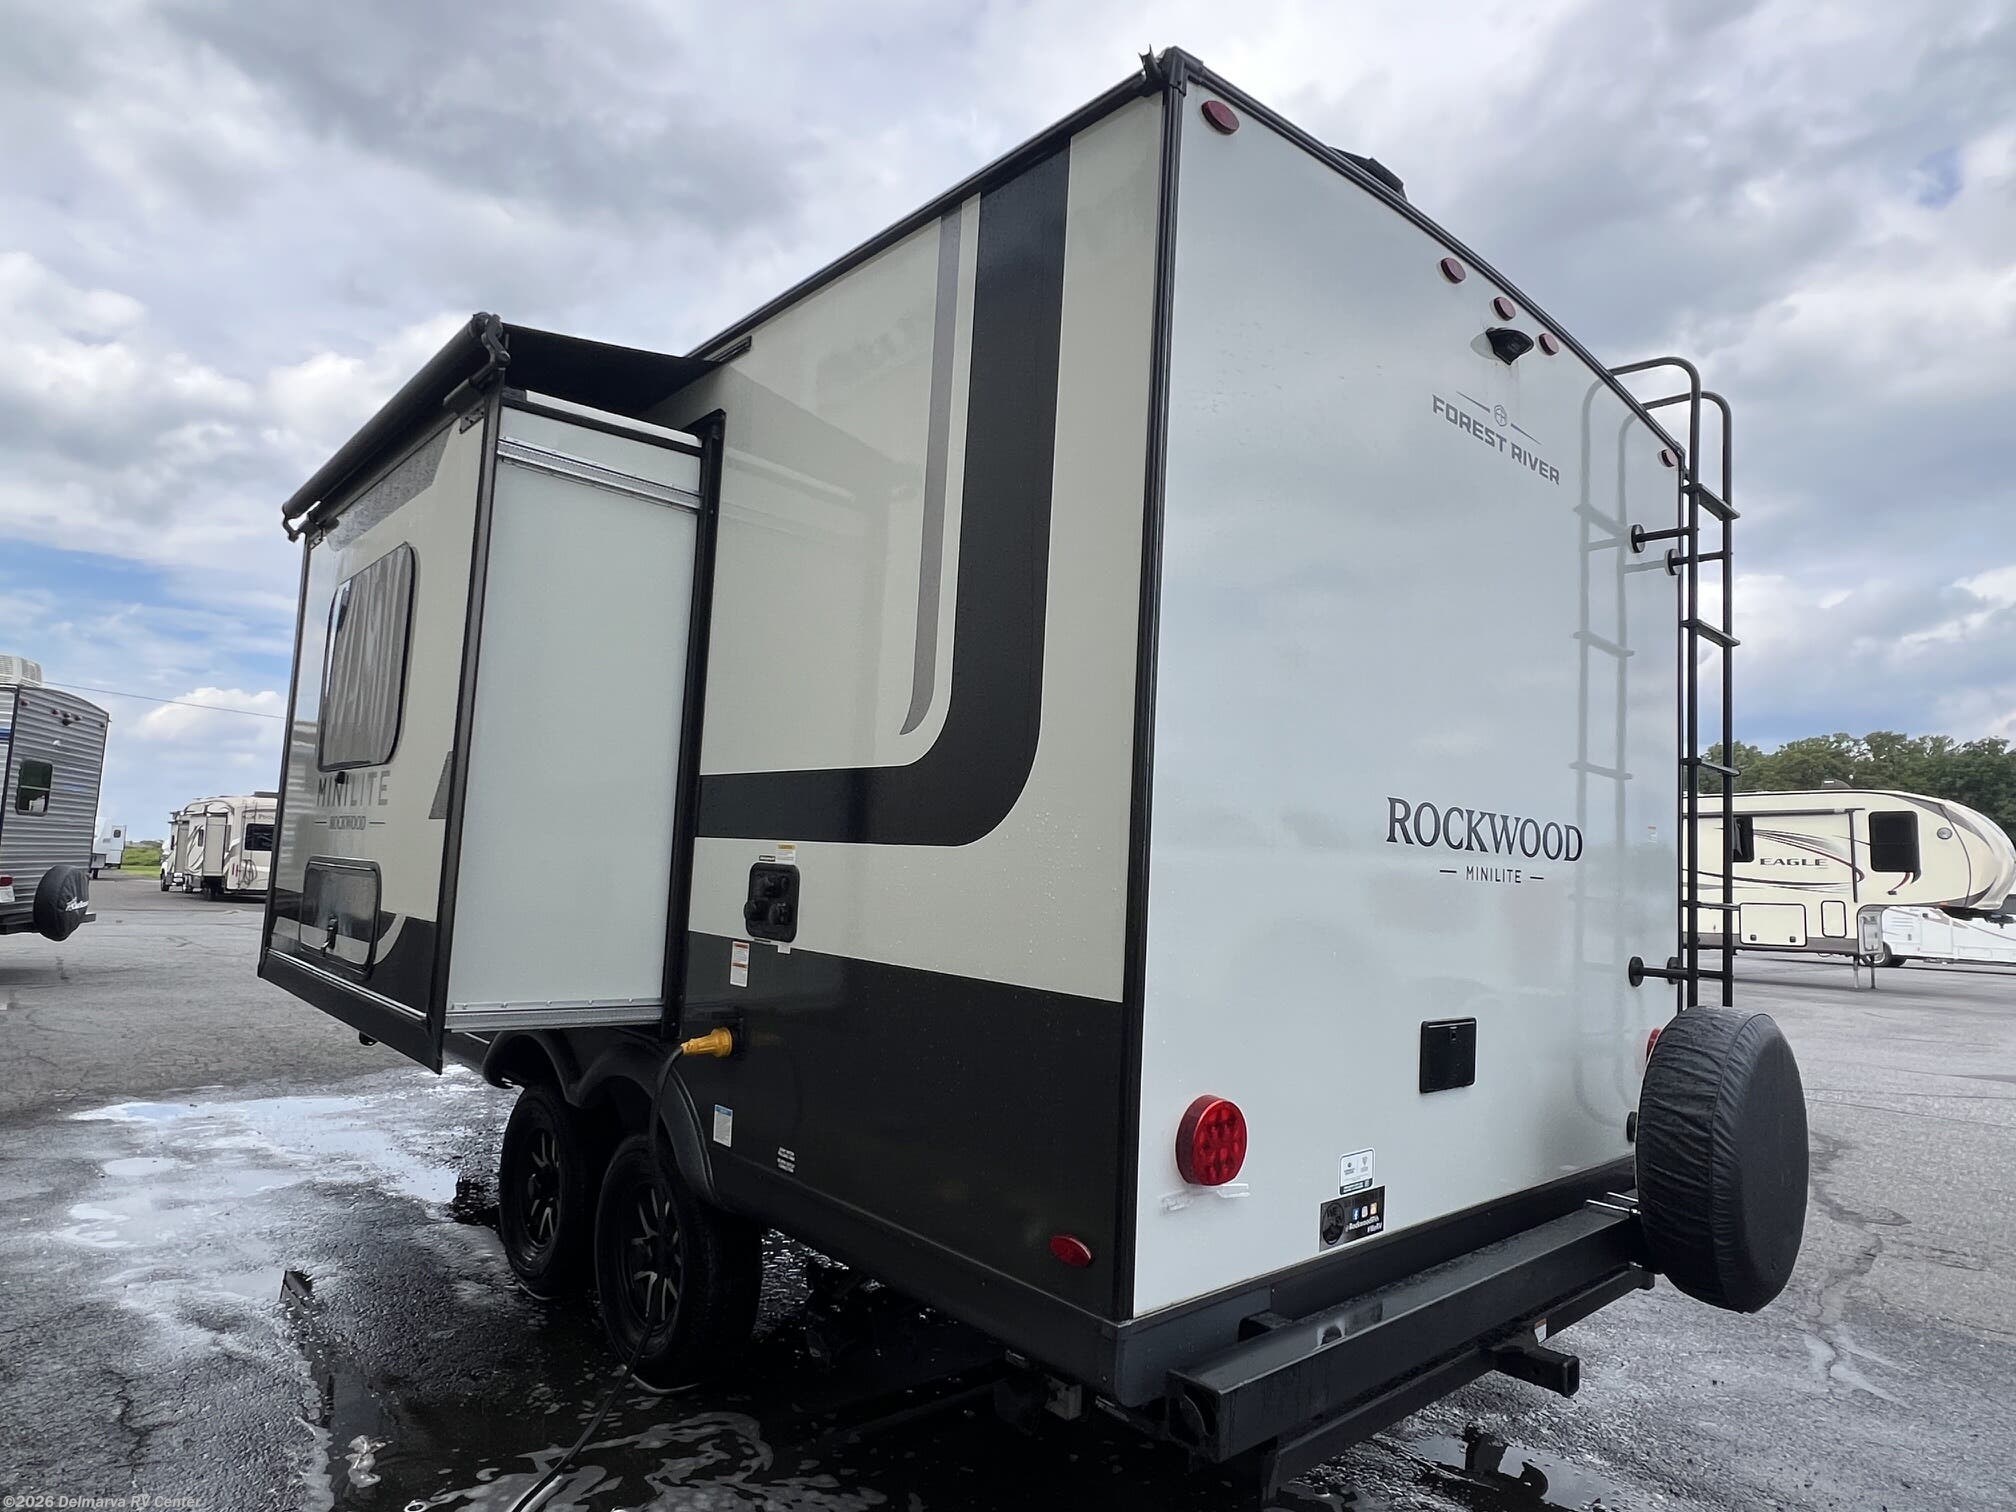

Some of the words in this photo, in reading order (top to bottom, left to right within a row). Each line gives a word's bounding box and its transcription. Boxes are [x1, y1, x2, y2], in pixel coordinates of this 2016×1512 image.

[1431, 393, 1507, 453] FOREST
[1510, 441, 1560, 486] RIVER
[316, 769, 392, 808] MINILITE
[1385, 796, 1584, 862] ROCKWOOD
[1465, 865, 1523, 884] MINILITE
[1760, 858, 1828, 866] EAGLE
